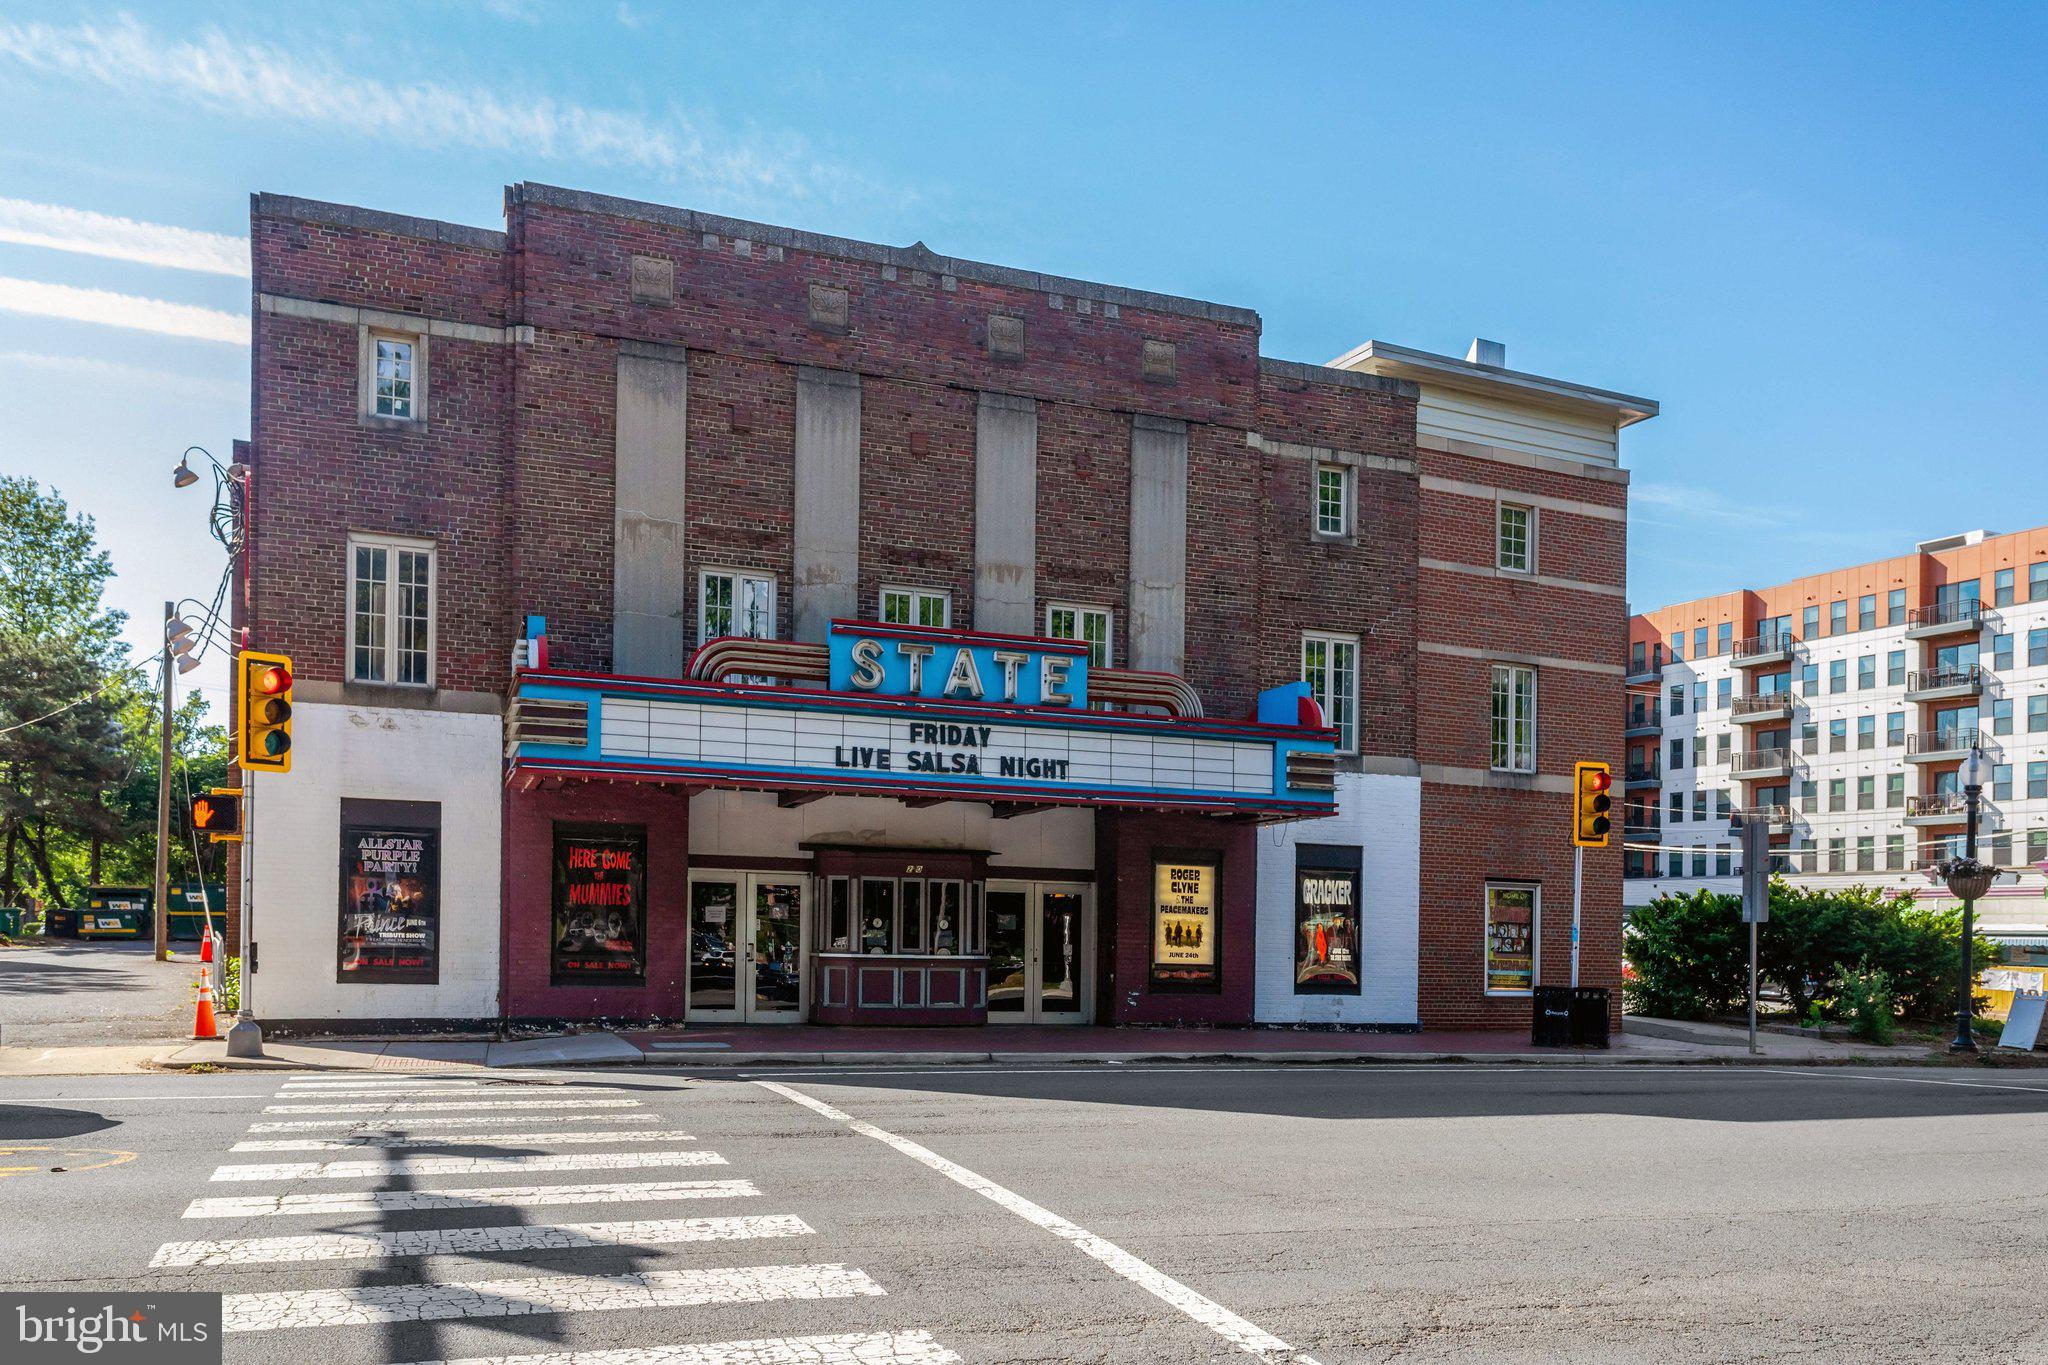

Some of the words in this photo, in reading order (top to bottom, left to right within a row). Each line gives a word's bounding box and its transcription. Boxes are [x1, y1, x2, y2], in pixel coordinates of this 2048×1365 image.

[850, 639, 1074, 703] STATE
[909, 723, 991, 747] FRIDAY
[835, 745, 891, 769] LIVE
[907, 750, 980, 775] SALSA
[1000, 755, 1070, 780] NIGHT
[358, 838, 424, 851] ALLSTAR
[361, 849, 421, 862] PURPLE
[569, 846, 597, 869] HERE
[601, 848, 631, 870] COME
[363, 861, 418, 873] PARTY!
[1170, 868, 1200, 881] ROGER
[569, 882, 631, 906] MUMMIES
[1170, 881, 1200, 894] CLYNE
[1303, 879, 1352, 905] CRACKER
[1181, 895, 1194, 904] THE
[1160, 905, 1209, 915] PEACEMAKERS
[357, 958, 368, 966] ON
[373, 958, 394, 966] SALE
[584, 961, 604, 969] SALE
